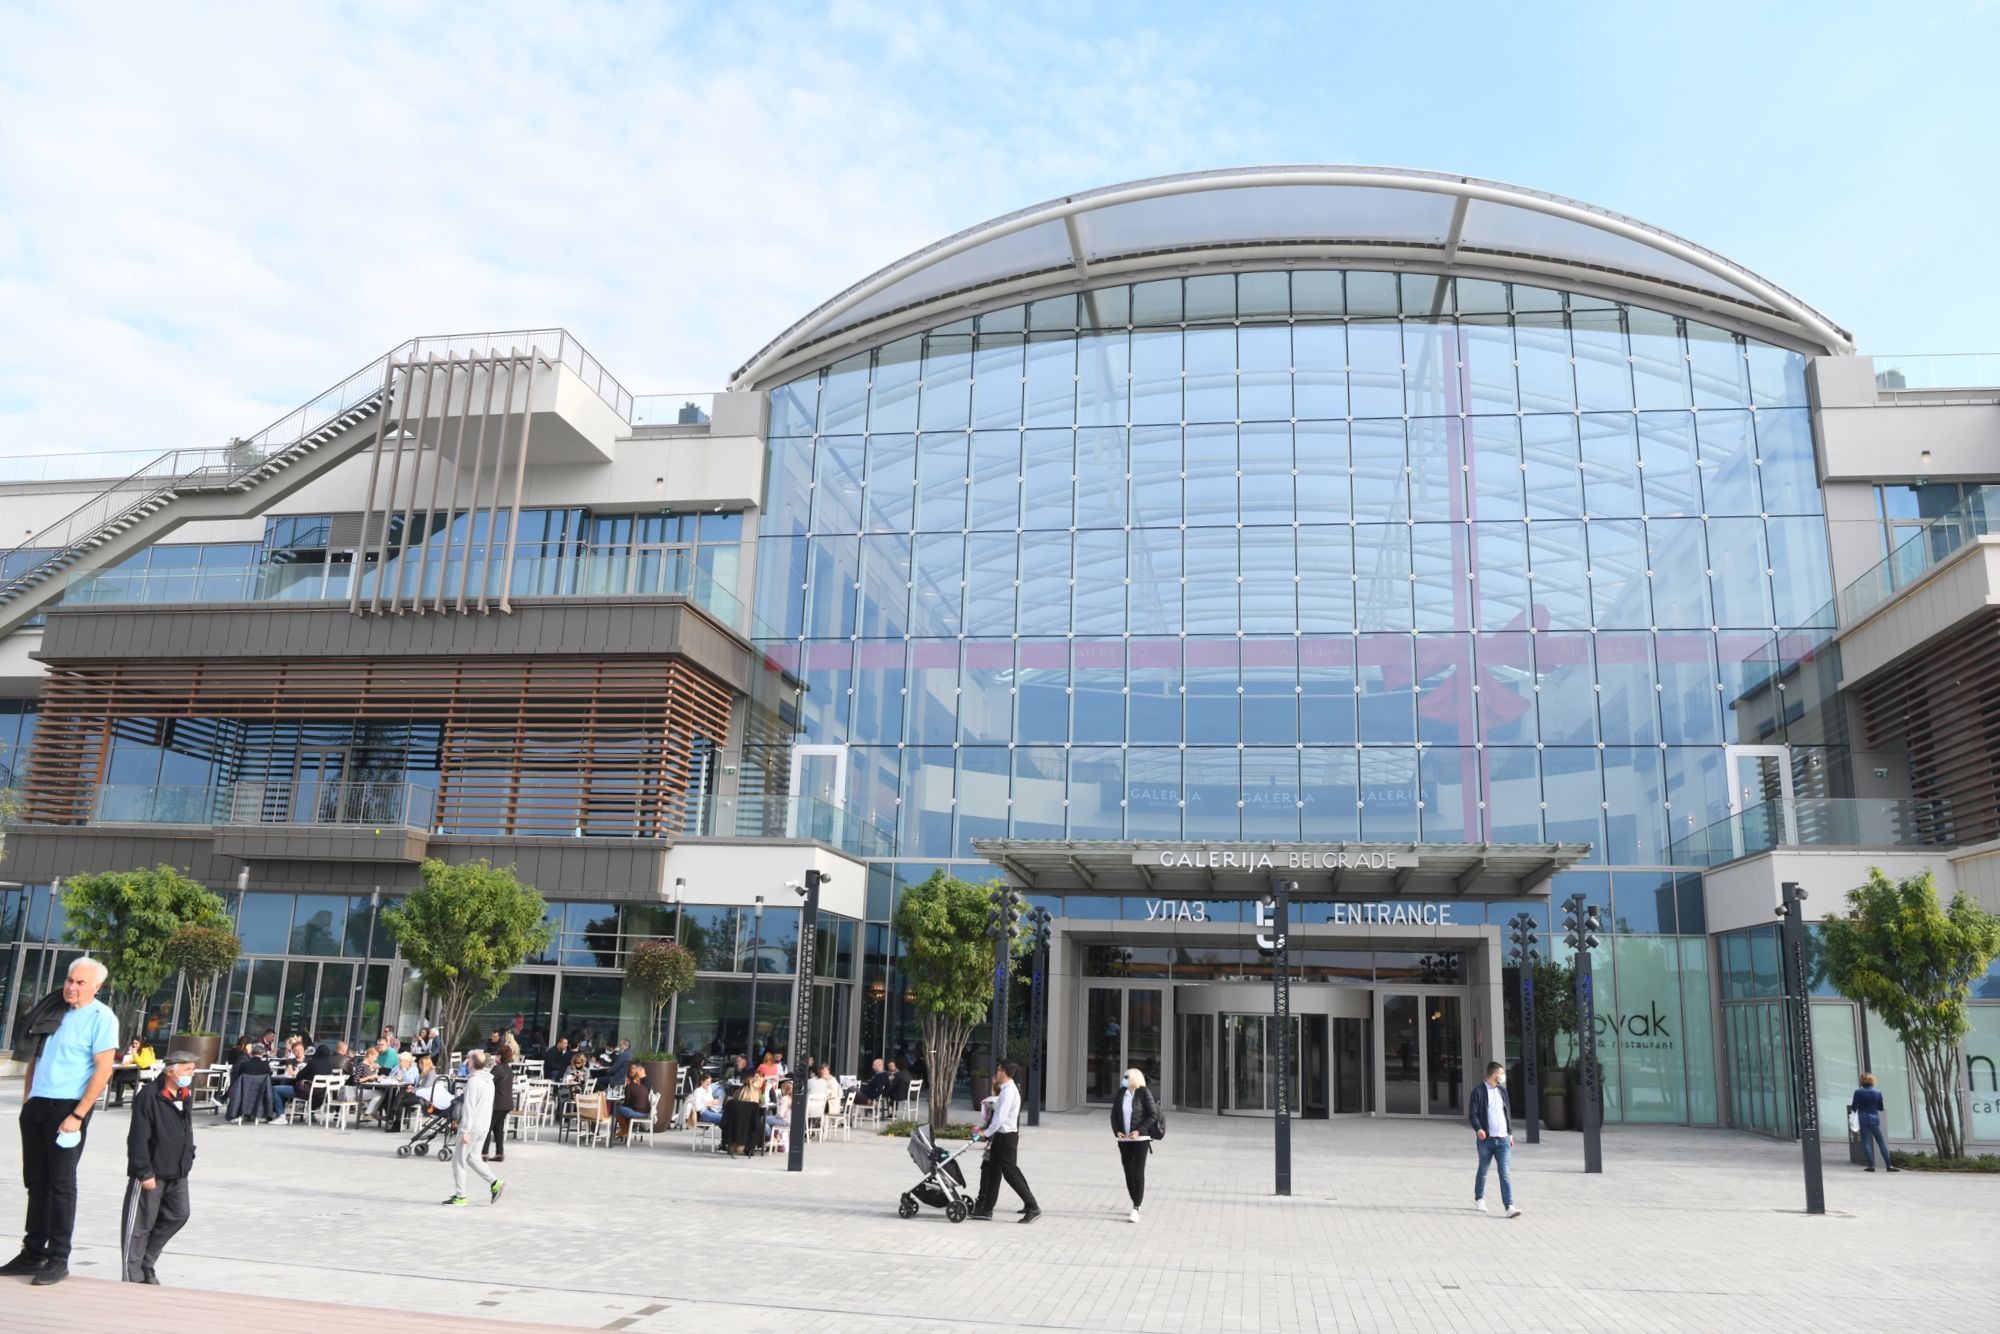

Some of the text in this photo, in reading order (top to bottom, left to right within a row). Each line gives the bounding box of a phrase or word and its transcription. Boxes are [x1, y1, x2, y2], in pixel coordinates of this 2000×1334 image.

[1130, 788, 1202, 804] GALERJA
[1159, 850, 1397, 873] GALERIJA BELGRADE
[1146, 900, 1205, 923] УЛАЗ
[1334, 902, 1452, 926] ENTRANCE
[1593, 999, 1670, 1037] ovak
[1612, 1039, 1673, 1050] rstaurant
